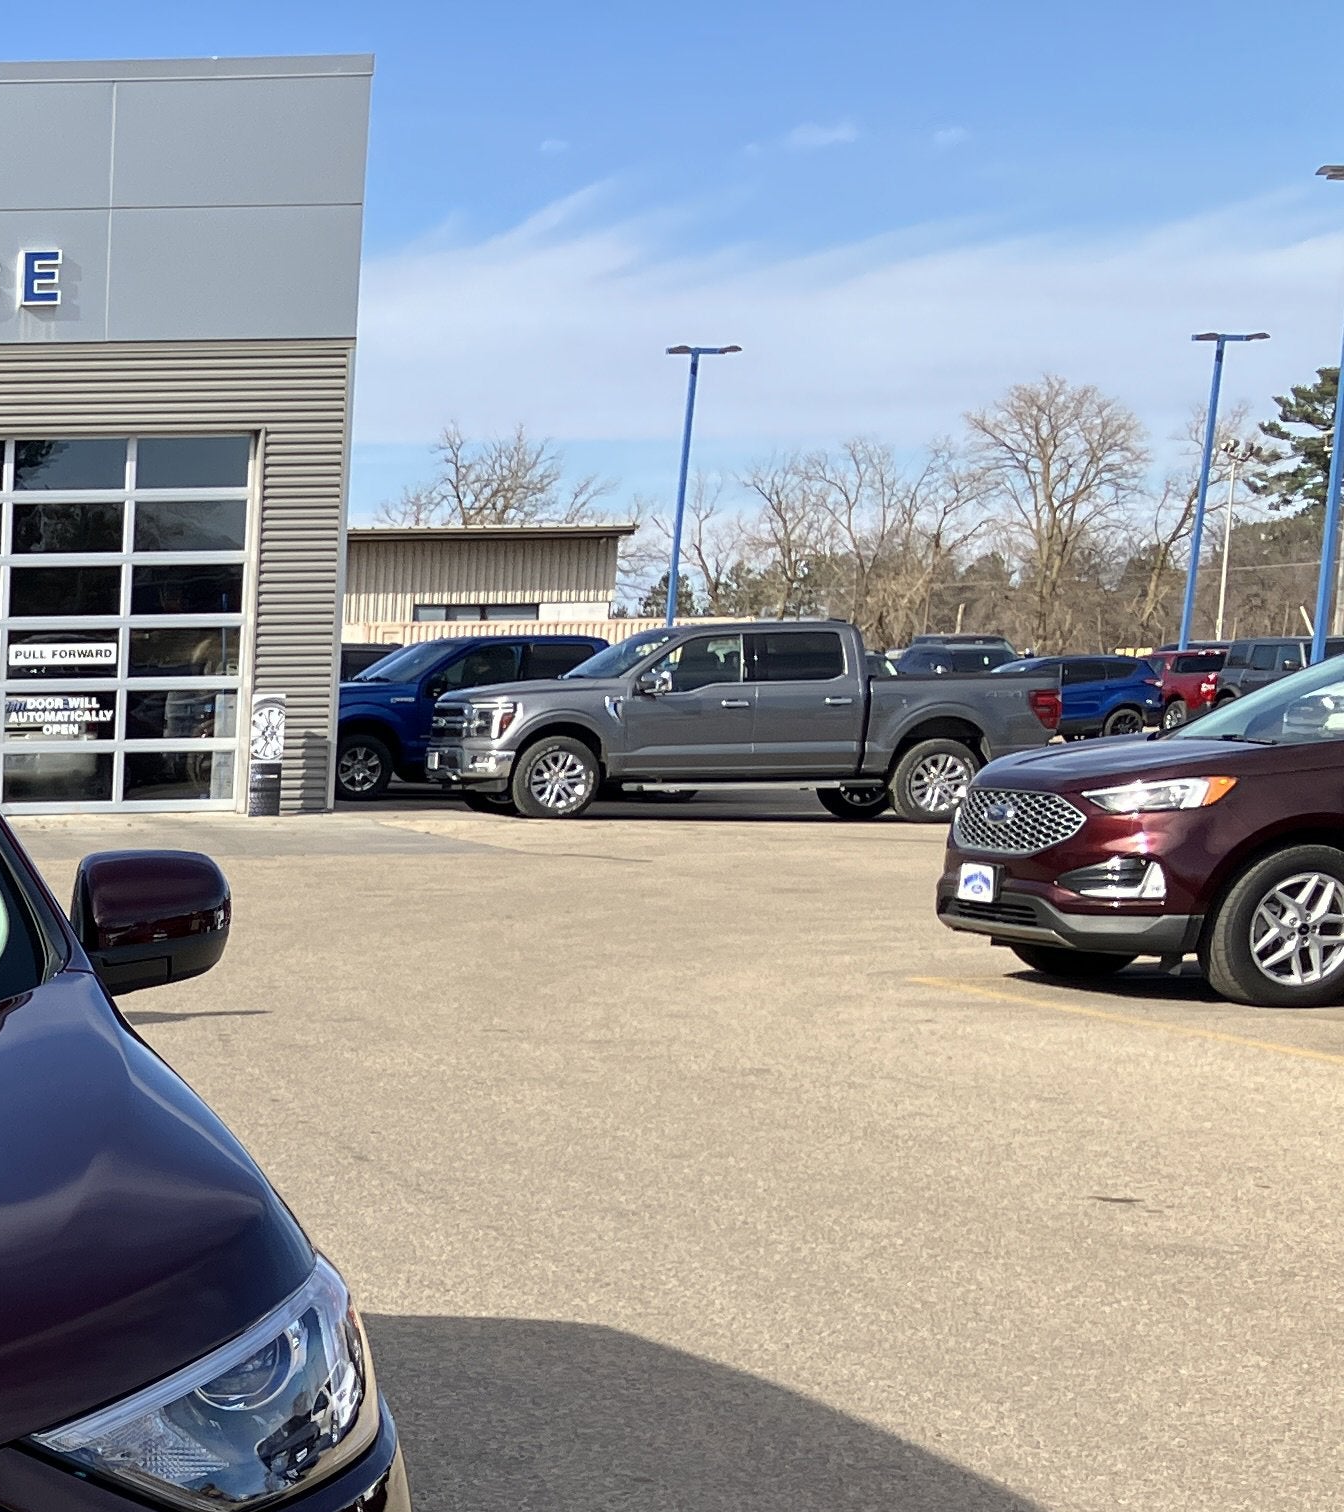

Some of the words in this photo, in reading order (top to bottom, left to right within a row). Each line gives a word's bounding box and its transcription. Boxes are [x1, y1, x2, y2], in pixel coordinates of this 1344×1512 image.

[14, 649, 47, 660] PULL
[51, 648, 112, 659] FORWARD
[26, 697, 63, 709] DOOR
[69, 697, 100, 708] WILL
[9, 710, 113, 722] AUTOMATICALLY
[42, 724, 79, 735] OPEN
